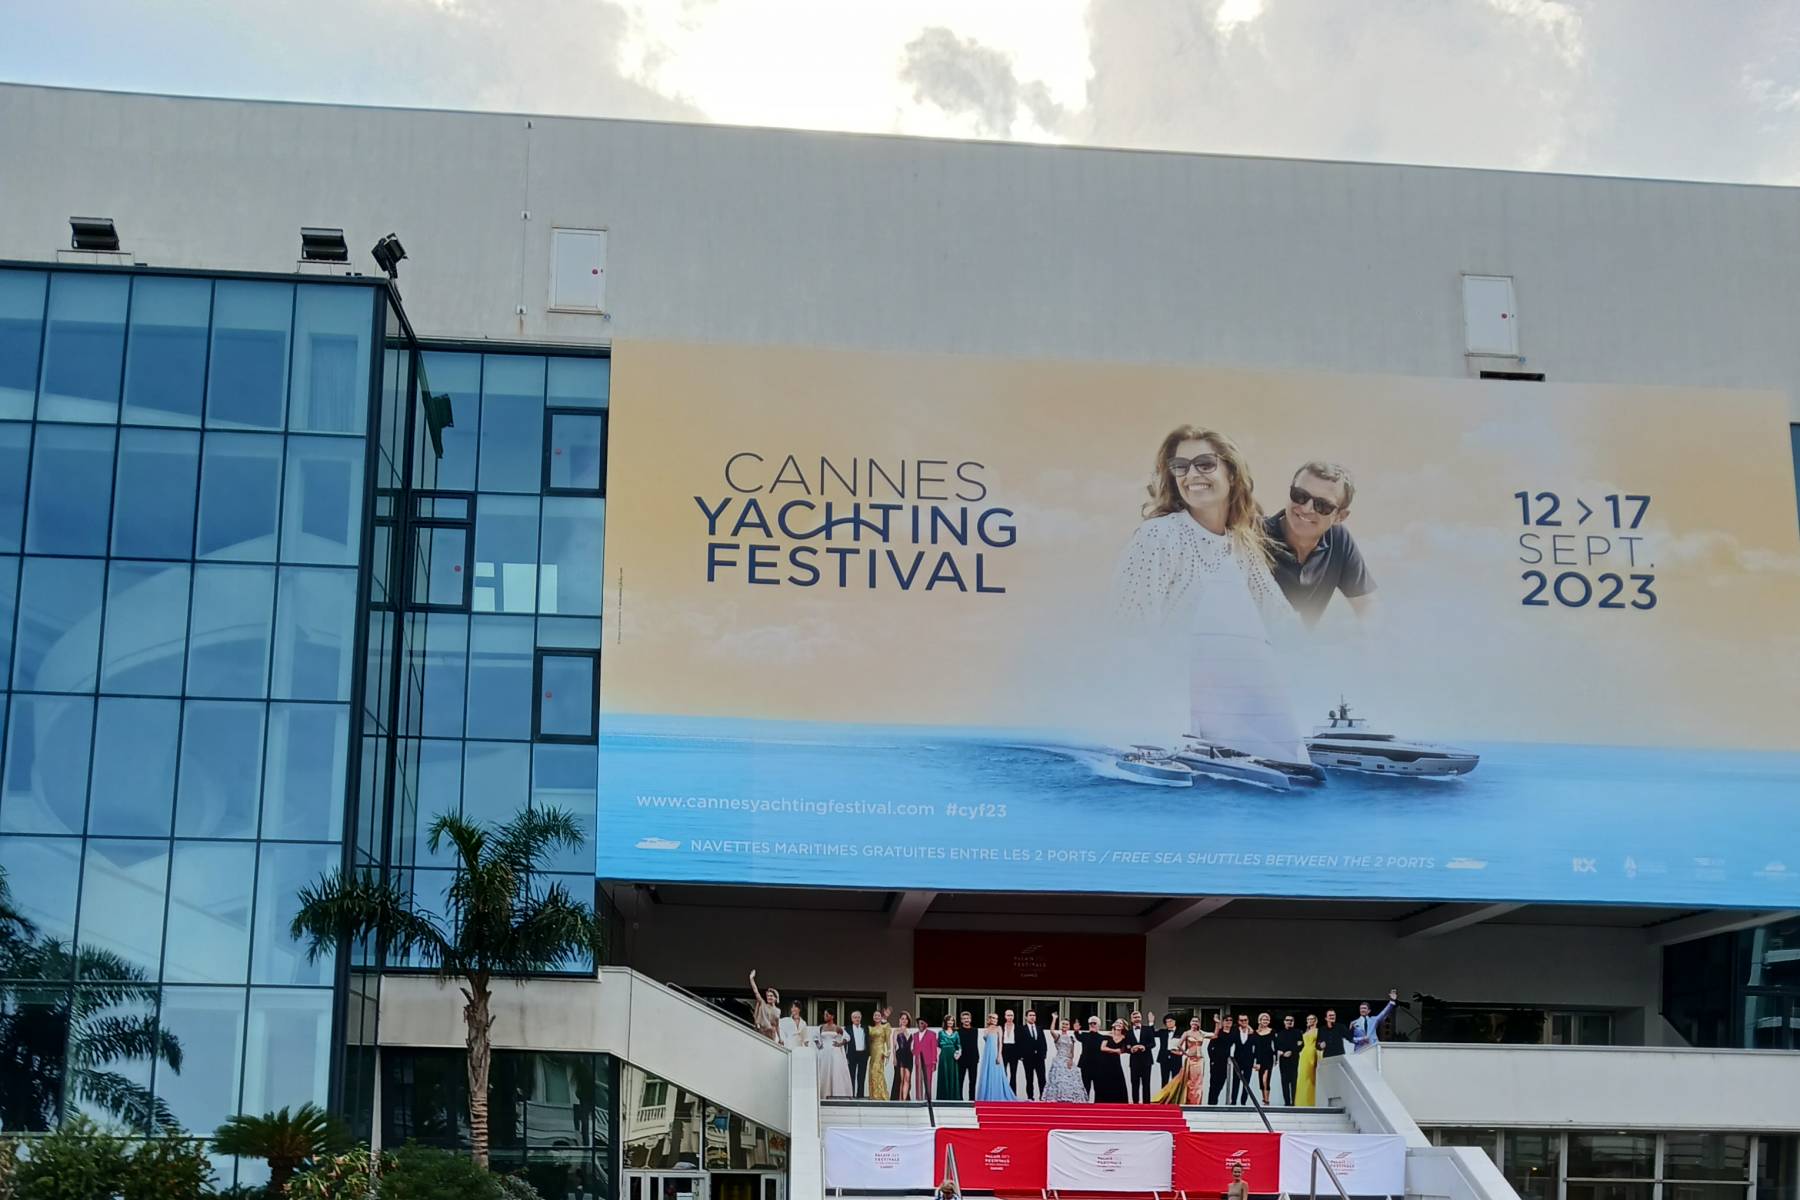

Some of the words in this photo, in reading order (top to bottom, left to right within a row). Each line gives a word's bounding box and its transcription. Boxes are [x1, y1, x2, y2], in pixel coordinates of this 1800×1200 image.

[725, 452, 987, 502] CANNES
[693, 495, 1017, 548] YACHTING
[1514, 491, 1562, 527] 12
[1605, 494, 1651, 529] 17
[707, 542, 1006, 594] FESTIVAL
[1519, 533, 1655, 568] SEPT.
[1521, 570, 1658, 611] 2023
[636, 795, 935, 816] www.cannesyachtingfestival.com
[946, 802, 1008, 820] #cyf23
[691, 839, 770, 854] NAVETTES
[775, 842, 858, 857] MARITIMES
[863, 845, 945, 859] GRATUITES
[951, 847, 999, 860] ENTRE
[1004, 848, 1030, 861] LES
[1035, 850, 1043, 861] 2
[1047, 850, 1097, 862] PORTS
[1112, 851, 1150, 864] FREE
[1154, 852, 1183, 864] SEA
[1187, 852, 1262, 865] SHUTTLES
[1266, 854, 1338, 867] BETWEEN
[1343, 855, 1371, 867] THE
[1374, 856, 1384, 867] 2
[1387, 856, 1435, 869] PORTS
